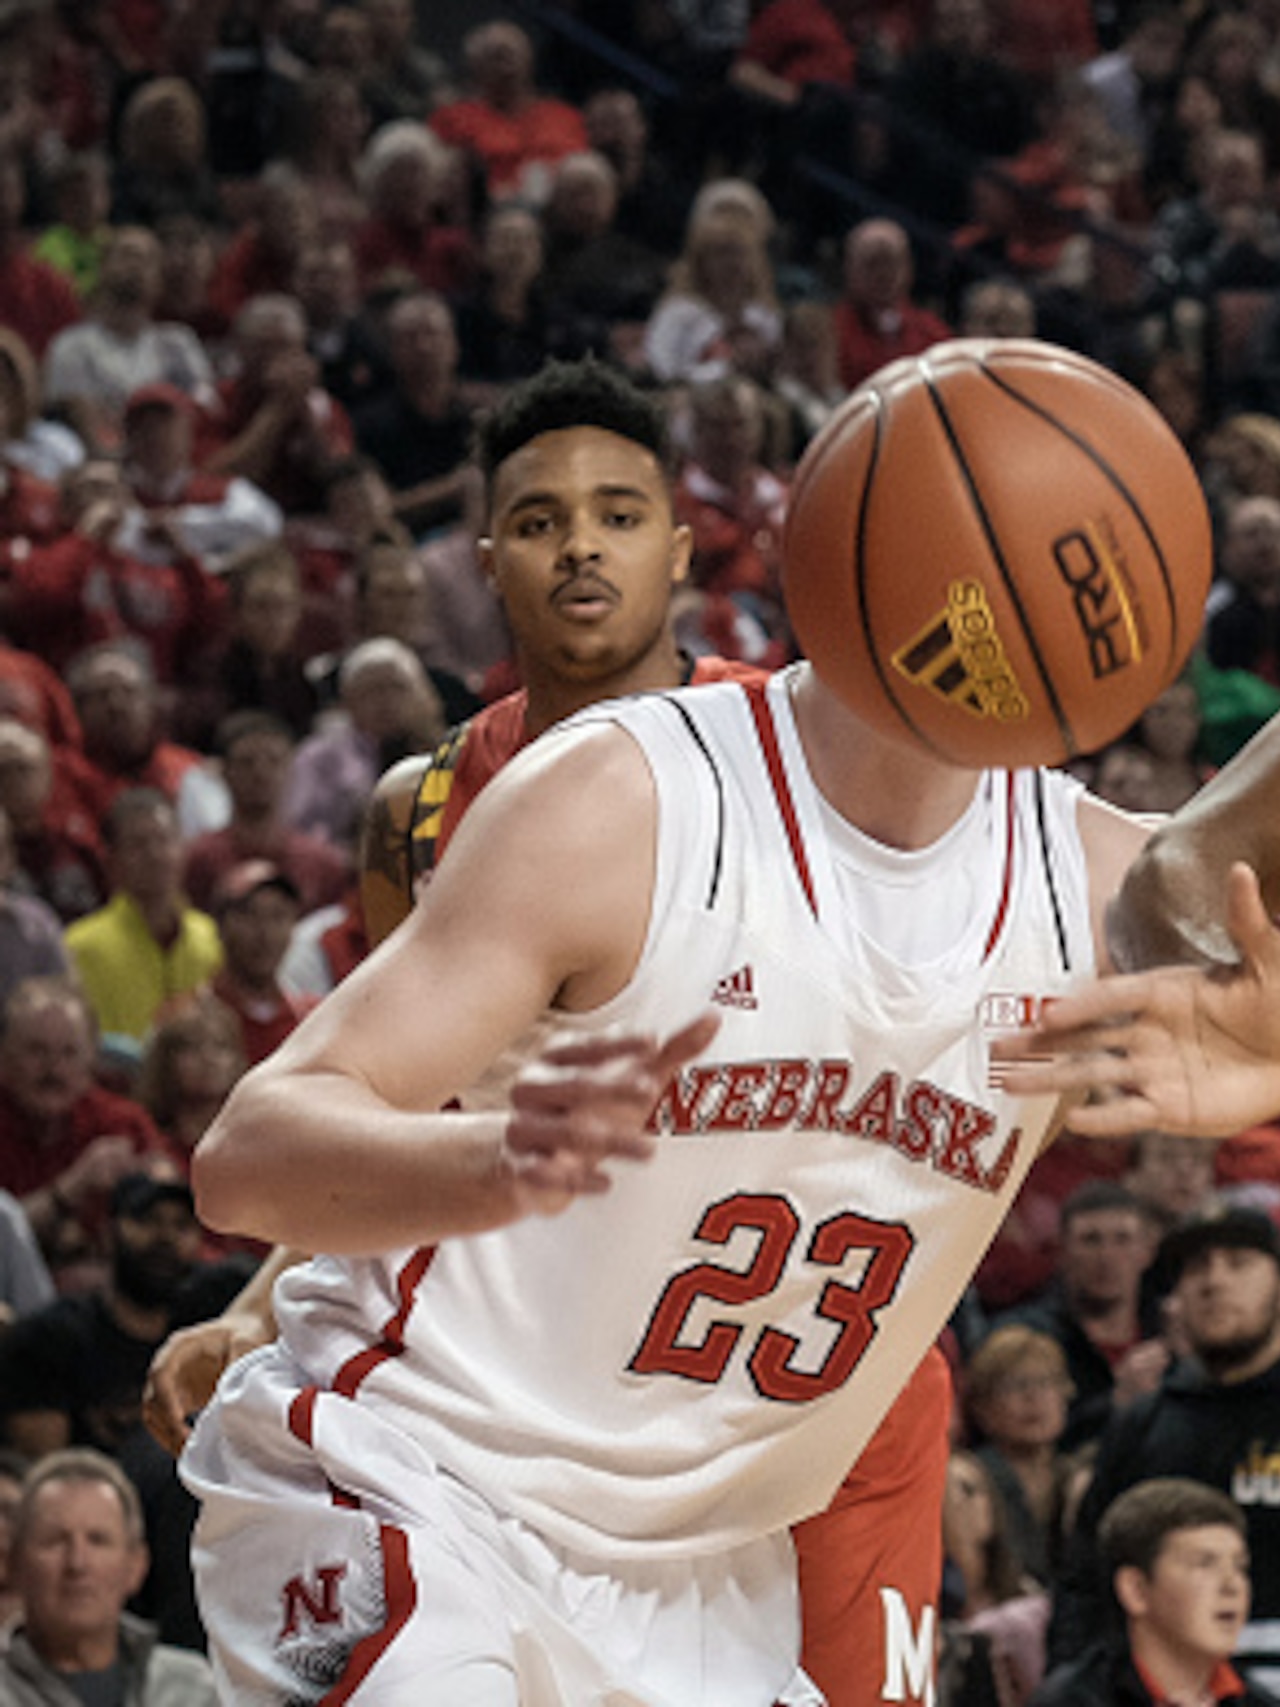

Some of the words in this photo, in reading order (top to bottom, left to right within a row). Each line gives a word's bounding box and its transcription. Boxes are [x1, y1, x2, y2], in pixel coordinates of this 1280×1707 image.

[1053, 530, 1128, 679] PRO
[624, 1189, 916, 1403] 23
[275, 1562, 348, 1647] N
